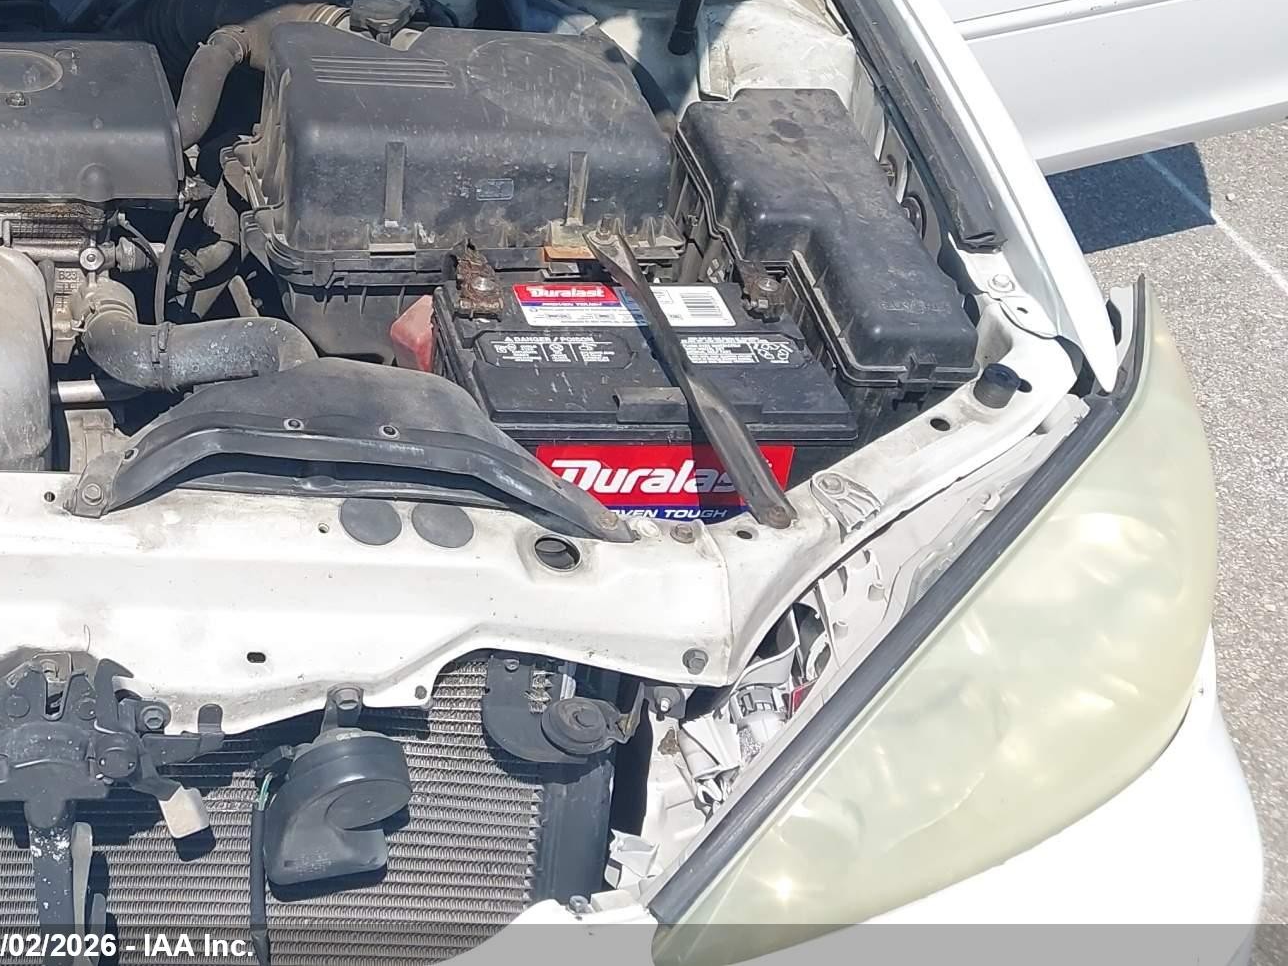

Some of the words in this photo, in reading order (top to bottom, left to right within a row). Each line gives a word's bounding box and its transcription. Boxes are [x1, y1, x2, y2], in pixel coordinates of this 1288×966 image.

[526, 285, 605, 298] Duralast
[551, 459, 737, 494] Duralas
[664, 509, 728, 519] TOUGH
